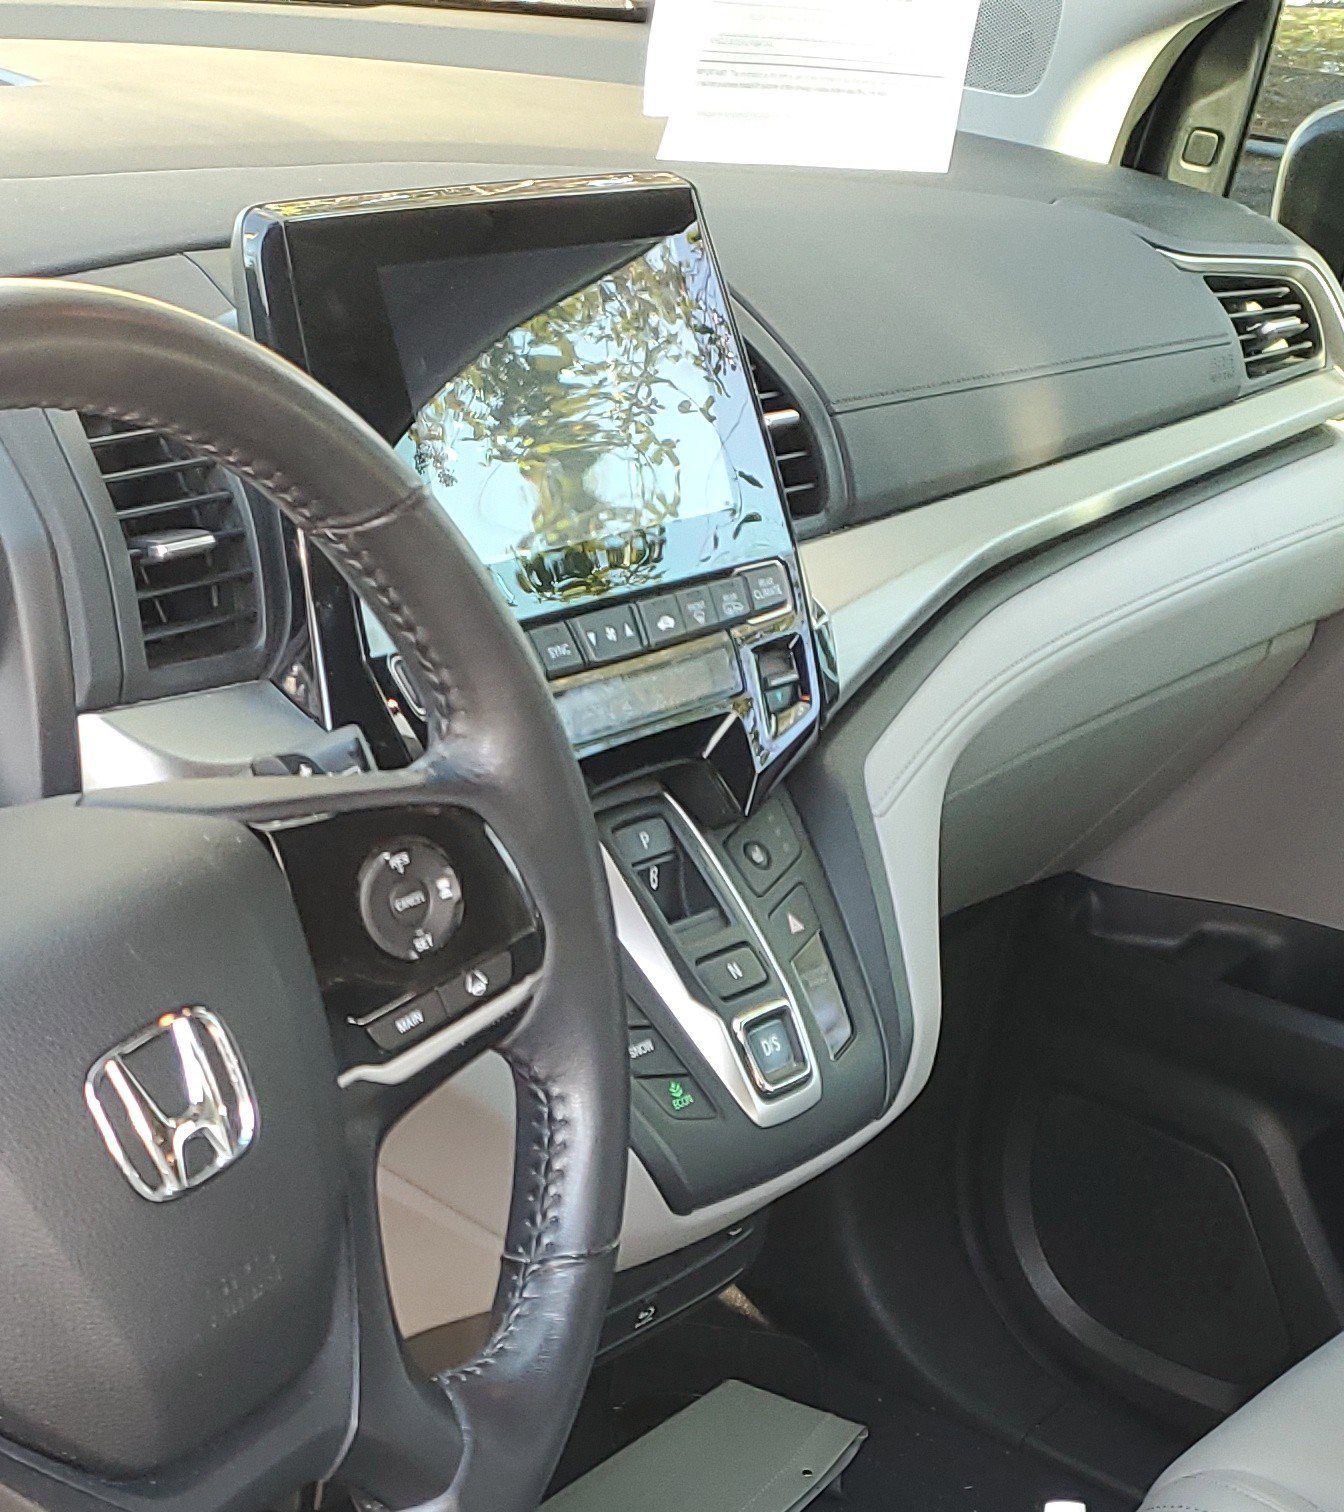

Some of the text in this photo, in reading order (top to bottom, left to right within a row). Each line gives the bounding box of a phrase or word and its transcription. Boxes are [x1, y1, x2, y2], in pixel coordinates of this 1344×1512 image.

[639, 831, 650, 849] P
[726, 961, 743, 980] N
[394, 1009, 424, 1034] MAIN
[628, 1039, 655, 1059] SNOW
[672, 1094, 693, 1111] ECON
